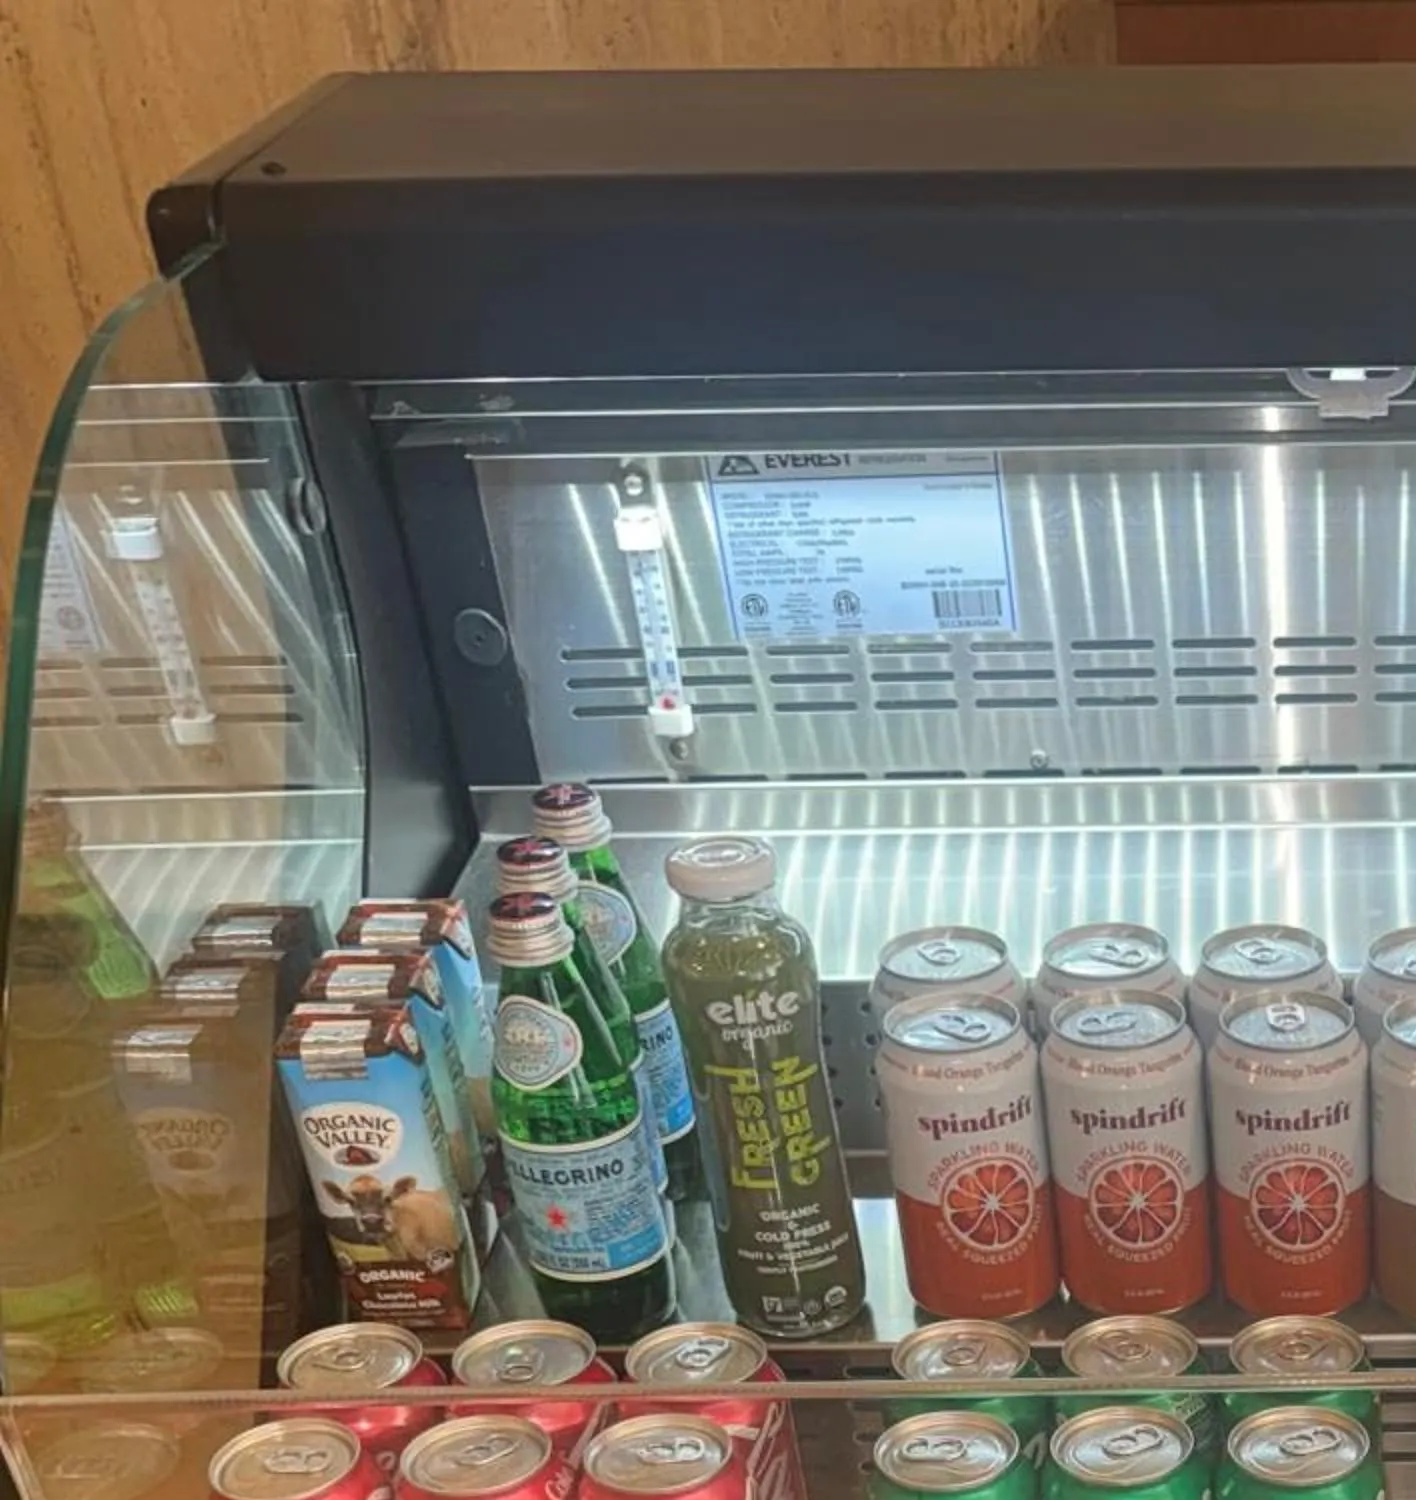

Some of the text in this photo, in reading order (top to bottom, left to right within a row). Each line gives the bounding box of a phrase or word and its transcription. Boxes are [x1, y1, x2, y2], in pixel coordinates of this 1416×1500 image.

[705, 990, 799, 1025] elite
[722, 1020, 793, 1050] organic
[303, 1114, 395, 1134] ORGANIC
[704, 1063, 780, 1189] FRESH
[771, 1055, 831, 1186] GREEN
[917, 1095, 1032, 1141] spindrift
[1070, 1097, 1186, 1135] spindrift
[1235, 1099, 1351, 1136] spindrift
[316, 1130, 389, 1150] VALLEY
[755, 1231, 790, 1242] COLD
[359, 1268, 426, 1284] ORGANIC
